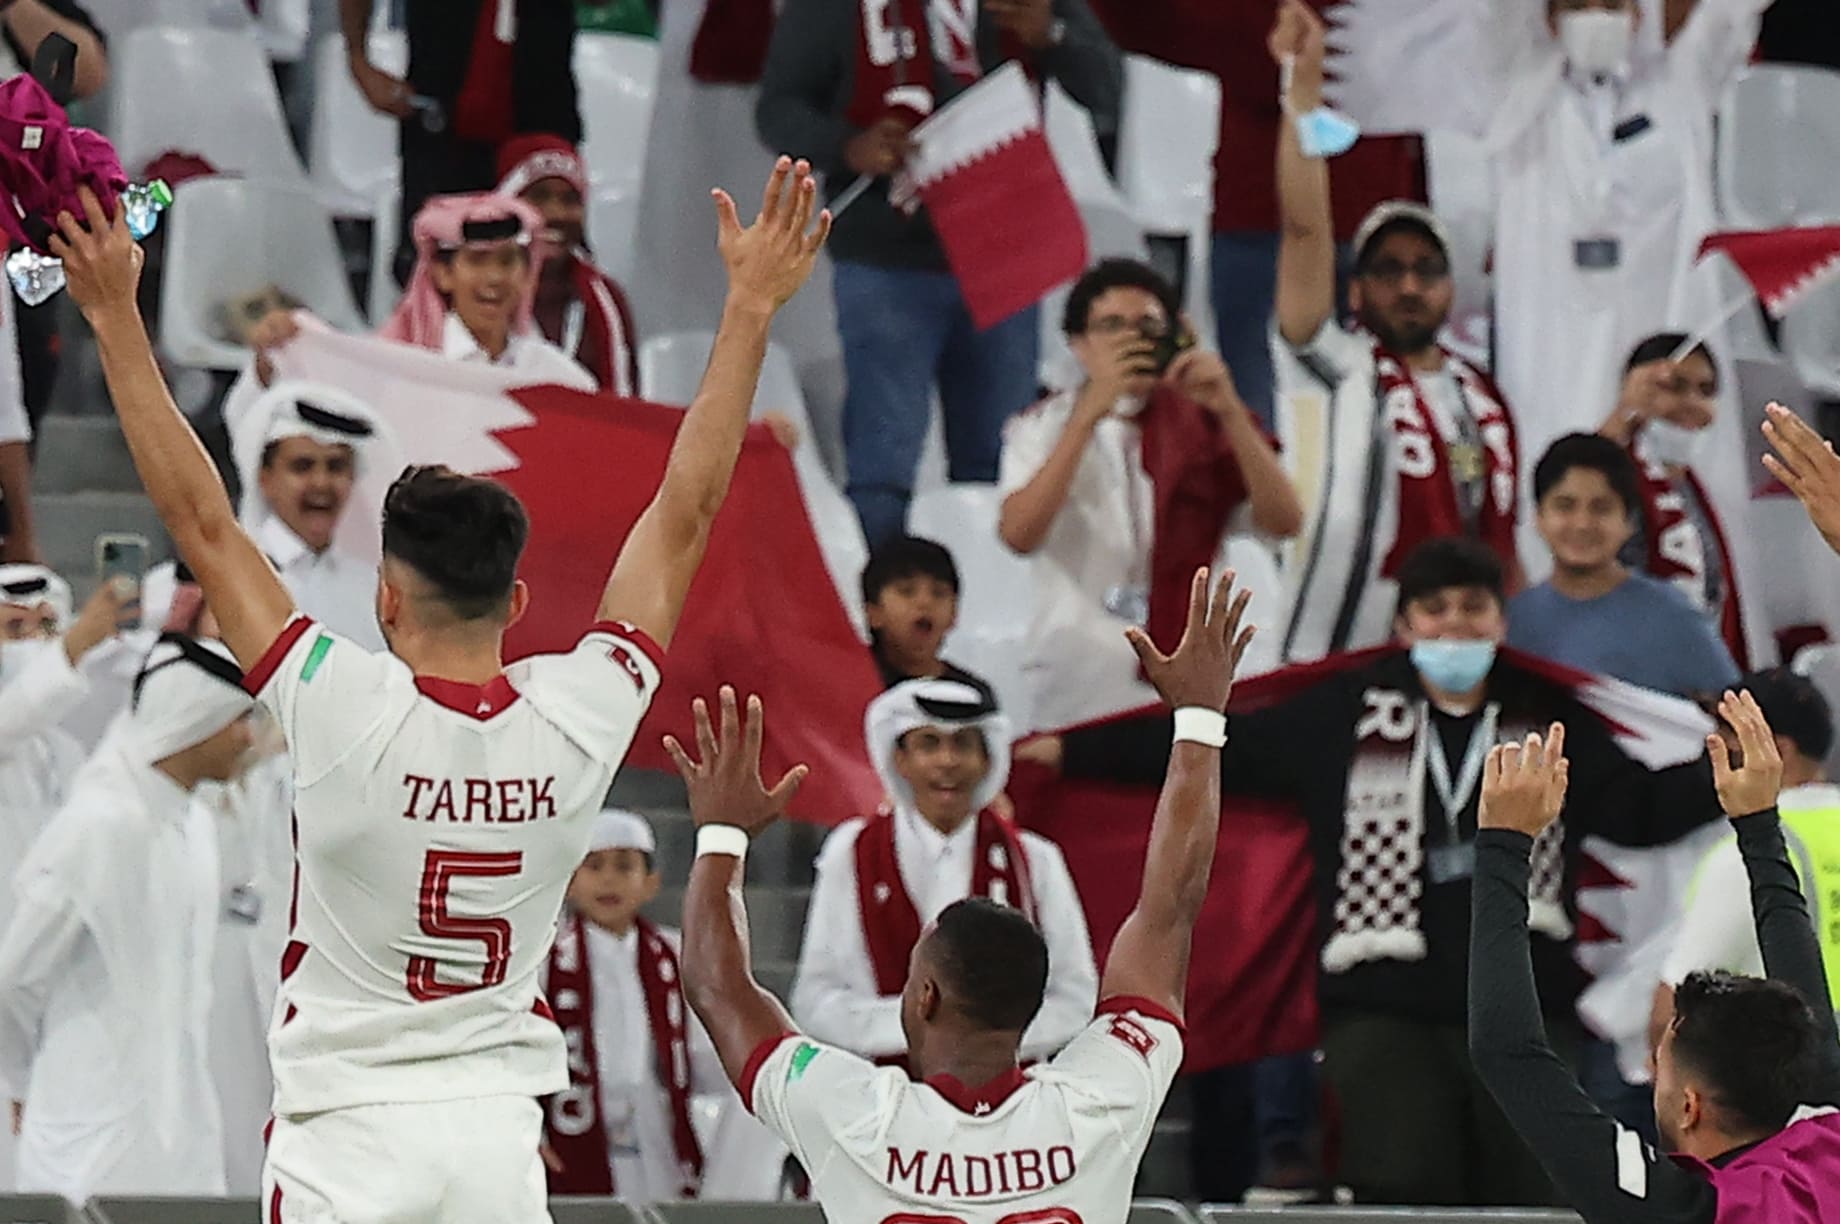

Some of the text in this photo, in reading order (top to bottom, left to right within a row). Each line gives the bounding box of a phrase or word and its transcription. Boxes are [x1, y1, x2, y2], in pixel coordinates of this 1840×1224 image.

[402, 772, 557, 823] TAREK
[406, 849, 523, 1003] 5
[886, 1145, 1077, 1197] MADIBO
